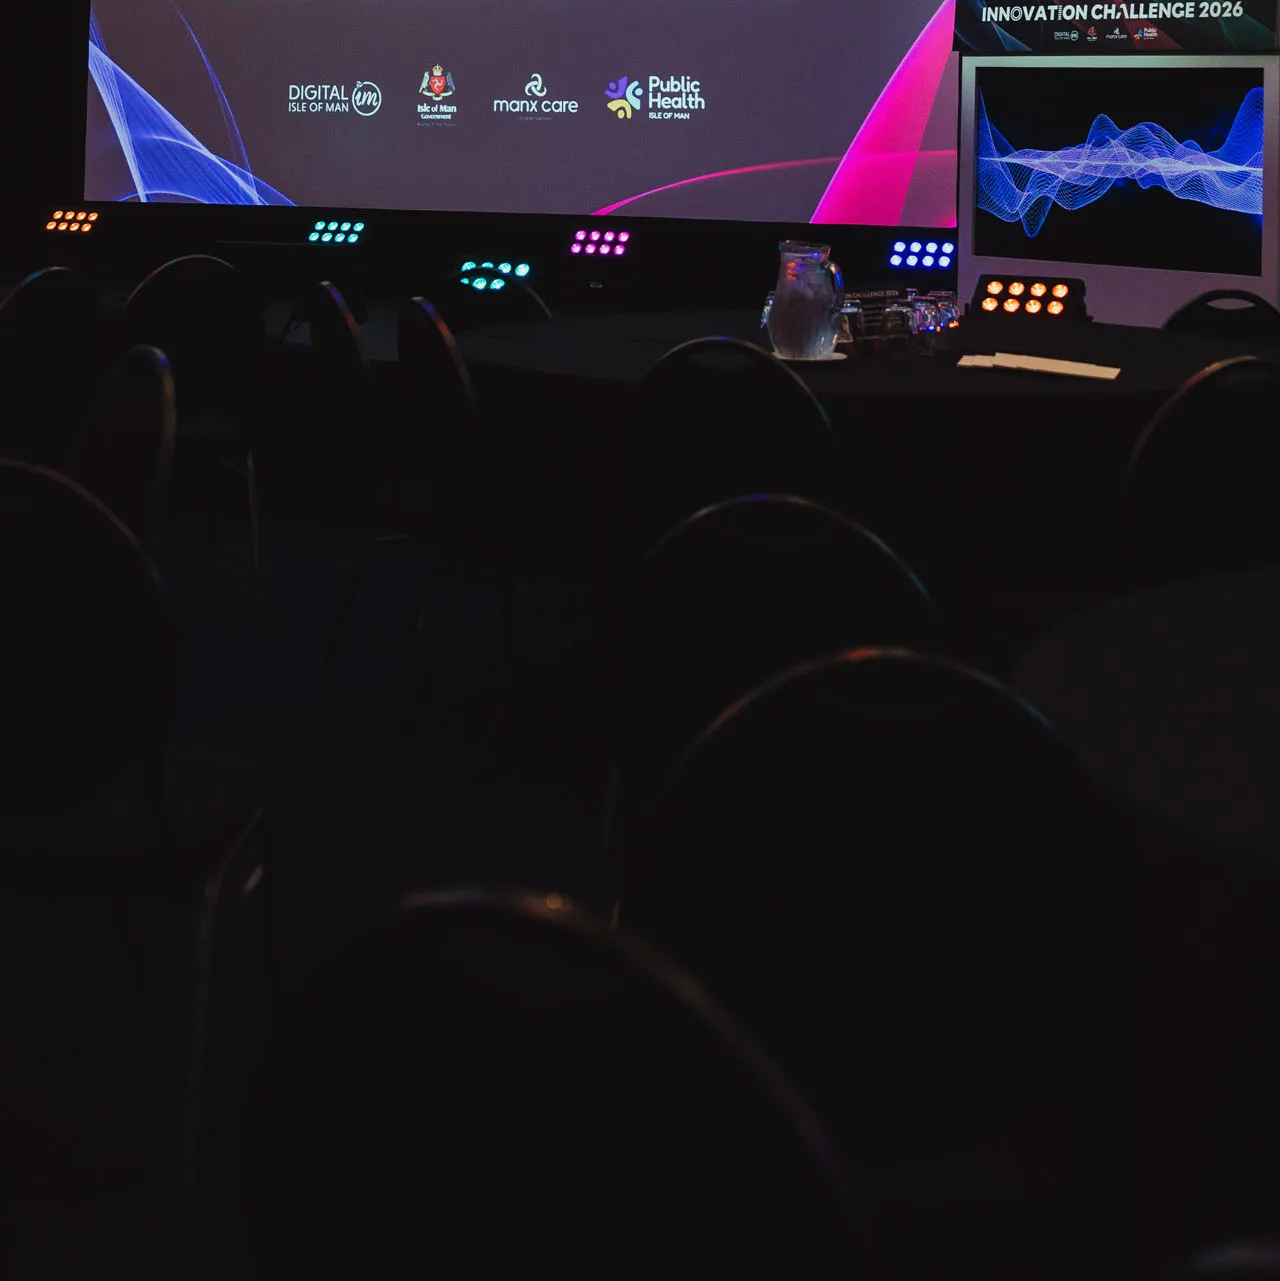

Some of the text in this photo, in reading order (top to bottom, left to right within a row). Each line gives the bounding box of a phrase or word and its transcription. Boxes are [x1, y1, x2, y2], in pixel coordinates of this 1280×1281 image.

[981, 1, 1243, 23] INNOVATION CHALLENGE 2026
[648, 75, 701, 94] Public
[289, 85, 348, 100] DIGITAL
[289, 102, 348, 112] ISLE OF MAN
[418, 103, 430, 112] Isle
[494, 100, 578, 112] manx care
[648, 93, 705, 110] Health
